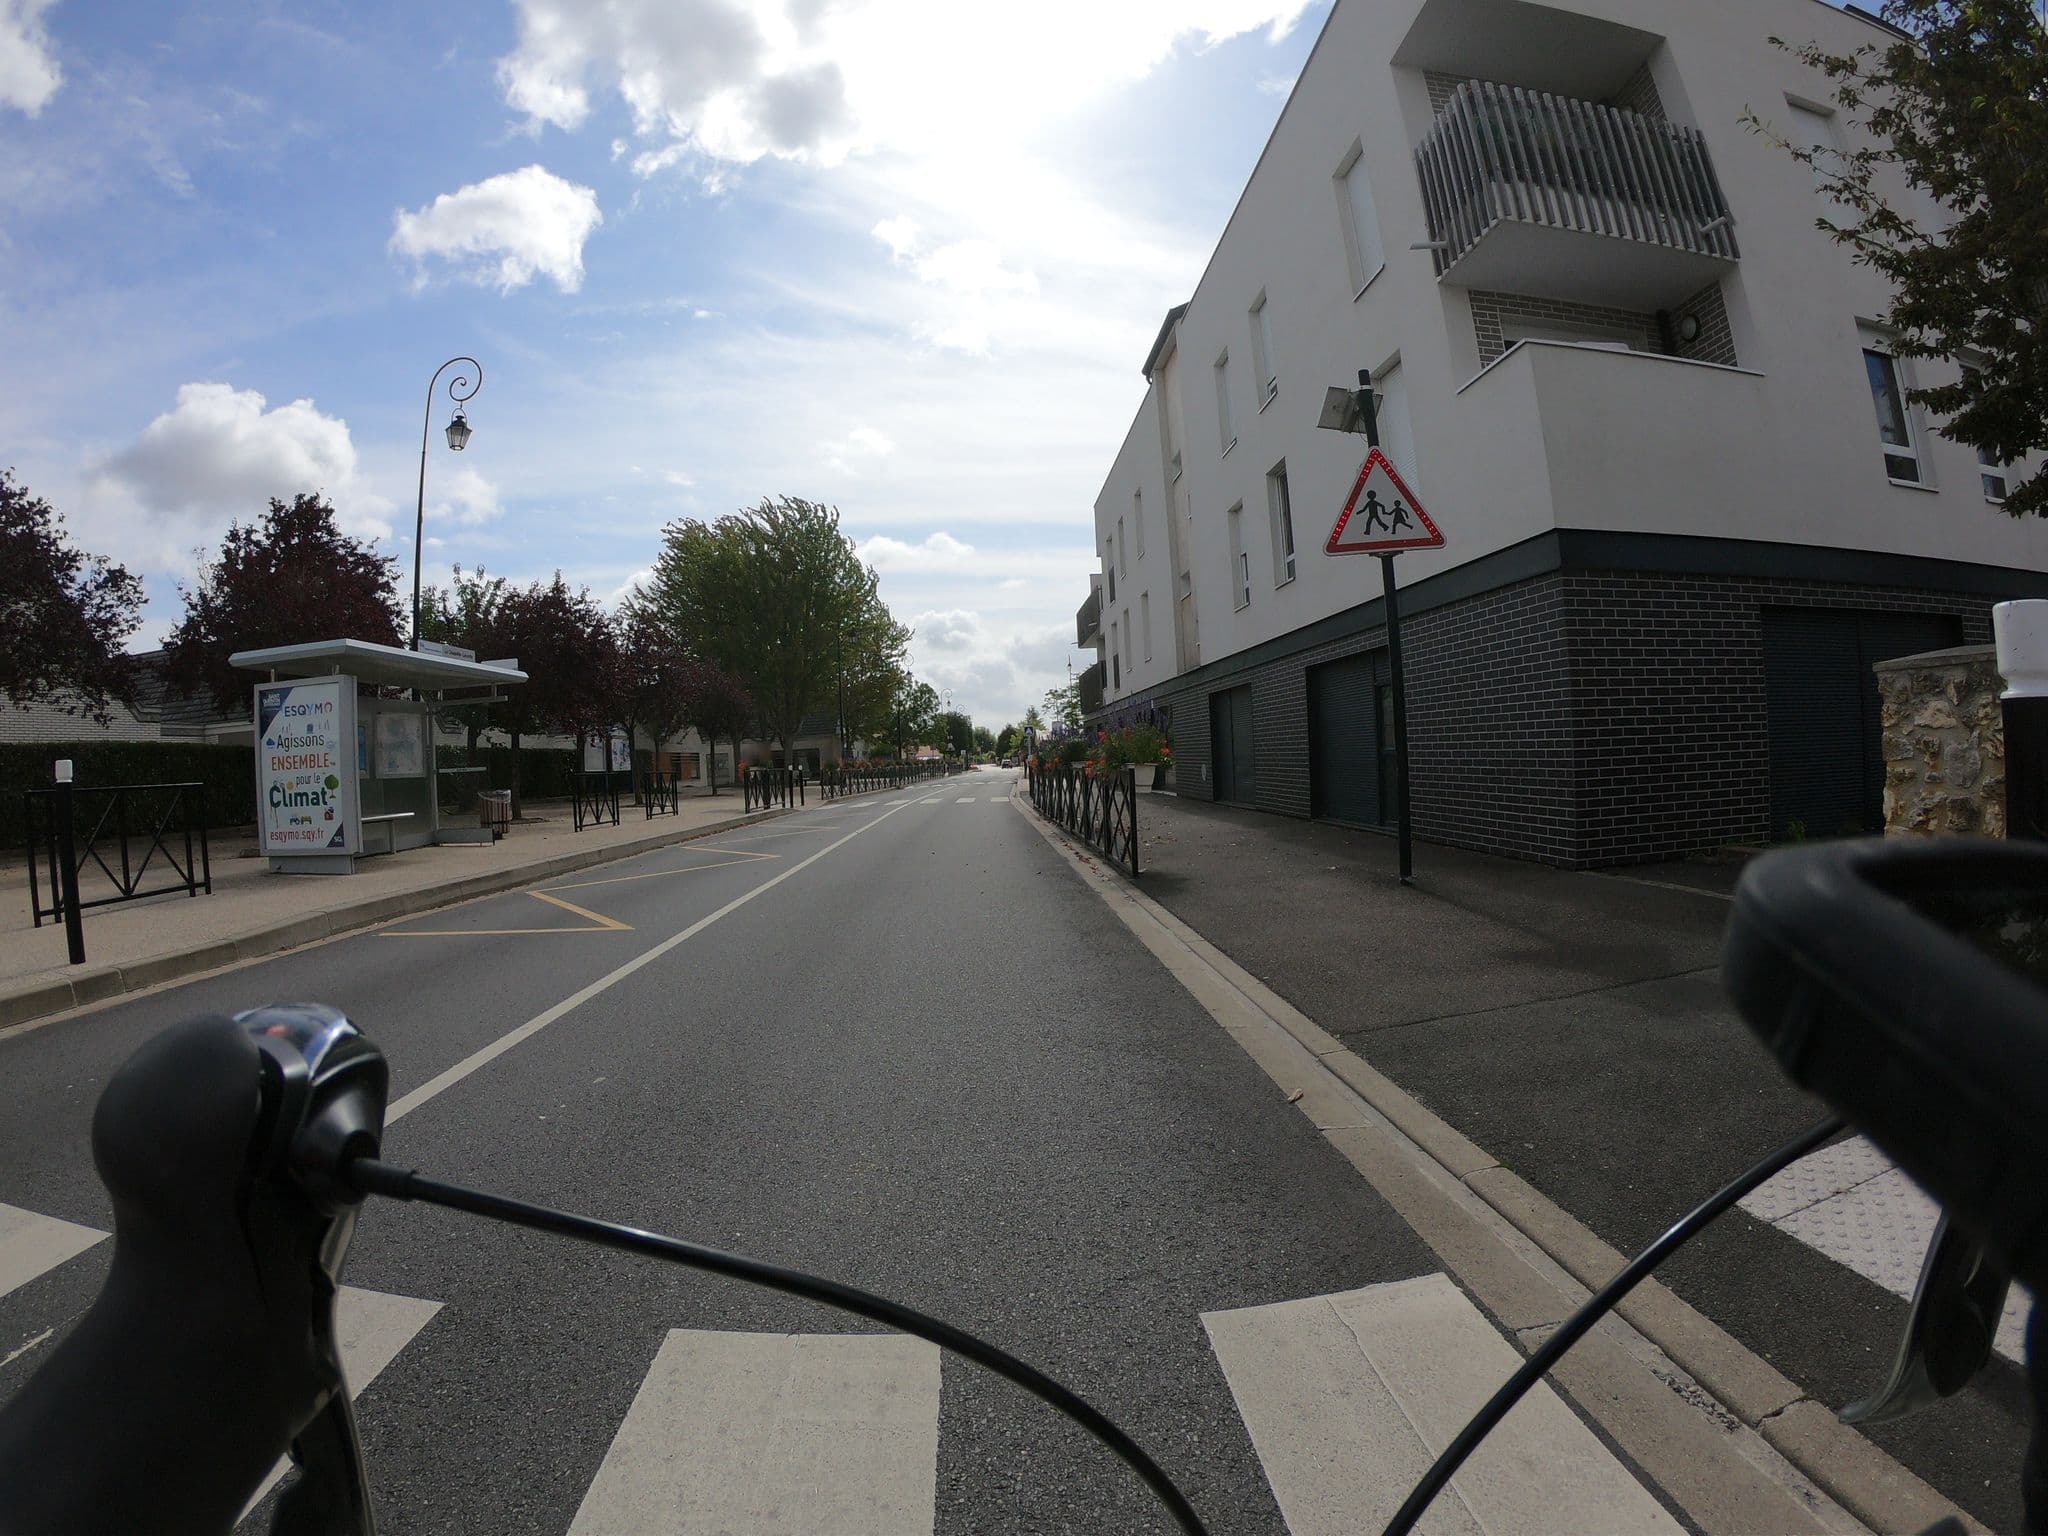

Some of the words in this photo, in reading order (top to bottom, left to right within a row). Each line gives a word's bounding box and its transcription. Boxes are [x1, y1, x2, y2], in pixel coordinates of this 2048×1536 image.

[284, 701, 333, 717] ESQYMO
[277, 733, 325, 752] Agissons
[271, 752, 330, 771] ENSEMBLE
[296, 775, 312, 788] pour
[314, 772, 321, 785] le
[269, 785, 328, 808] Climat
[270, 828, 325, 844] esqymo.sqy.fr
